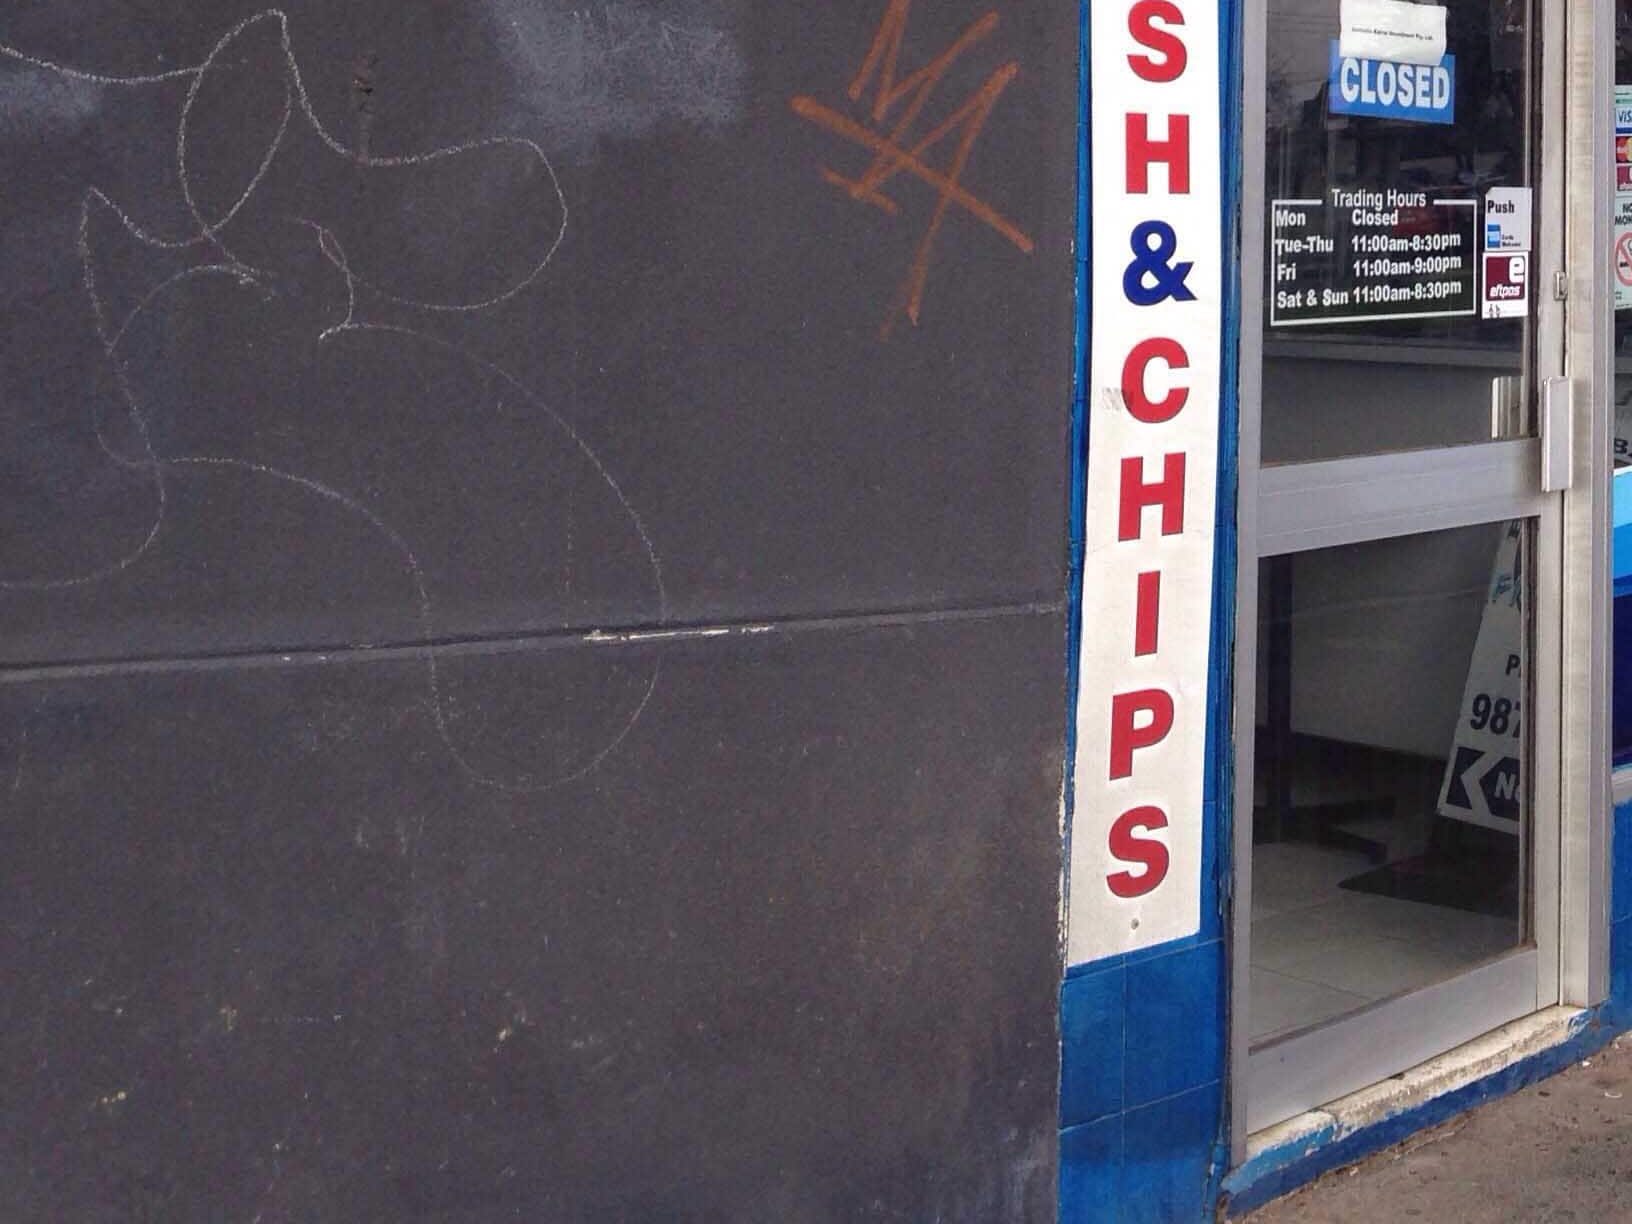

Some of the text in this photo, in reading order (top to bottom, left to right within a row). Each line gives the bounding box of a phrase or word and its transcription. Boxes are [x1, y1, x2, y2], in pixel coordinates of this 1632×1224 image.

[1341, 57, 1450, 109] CLOSED
[1332, 189, 1426, 210] Trading Hours
[1487, 200, 1515, 213] Push
[1275, 209, 1398, 226] Mon Closed
[1275, 236, 1334, 255] Tue-Thu
[1277, 264, 1296, 281] Fri
[1277, 290, 1302, 309] Sat
[1306, 289, 1317, 306] &
[1323, 289, 1348, 306] Sun
